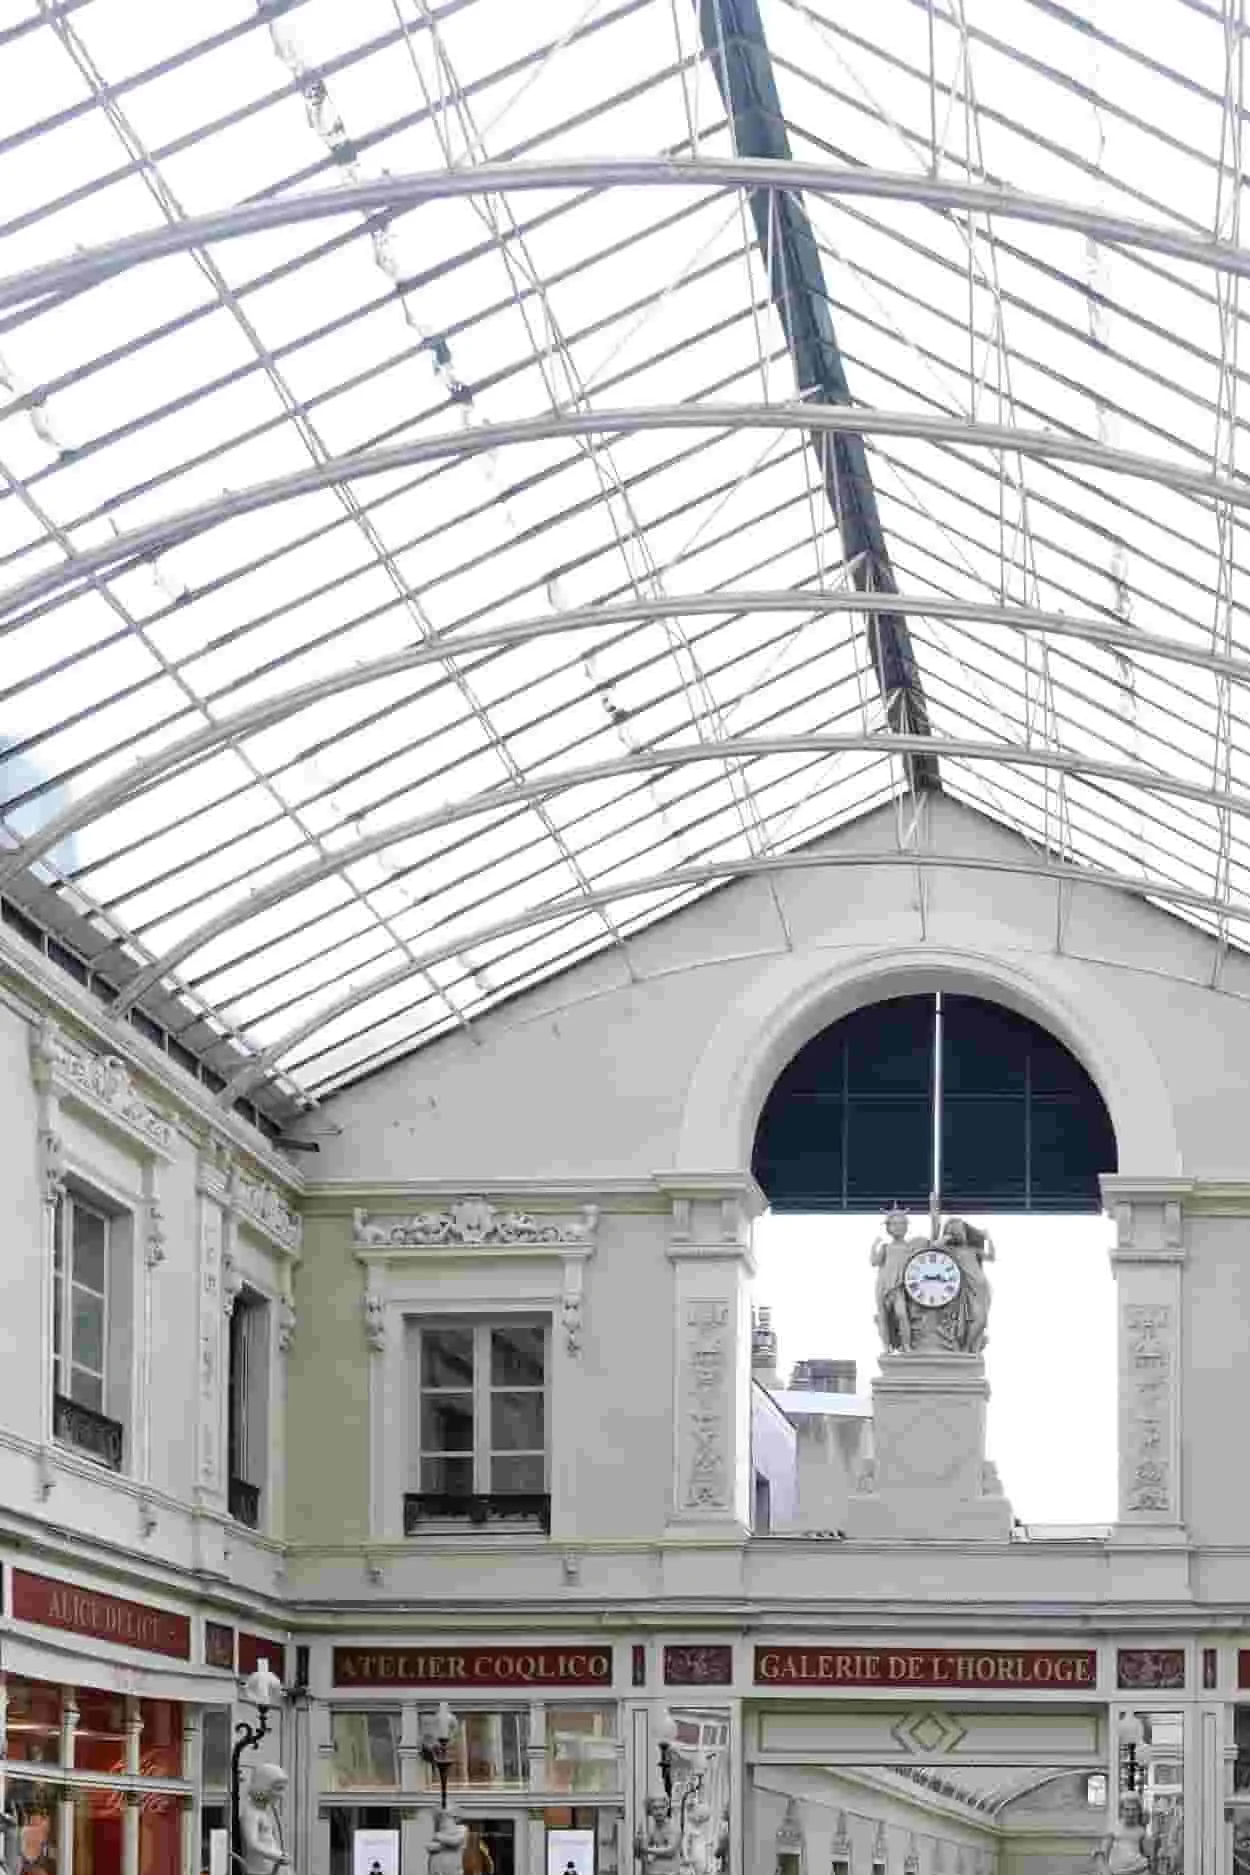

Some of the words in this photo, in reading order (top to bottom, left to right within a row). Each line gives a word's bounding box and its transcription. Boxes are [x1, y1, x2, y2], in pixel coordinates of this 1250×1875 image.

[48, 1590, 97, 1629] ALICE
[341, 1655, 467, 1679] ATELIER
[474, 1655, 609, 1680] COQLICO
[760, 1654, 881, 1679] GALERIE
[889, 1656, 925, 1680] DE
[933, 1656, 1095, 1682] L'HORLOGE
